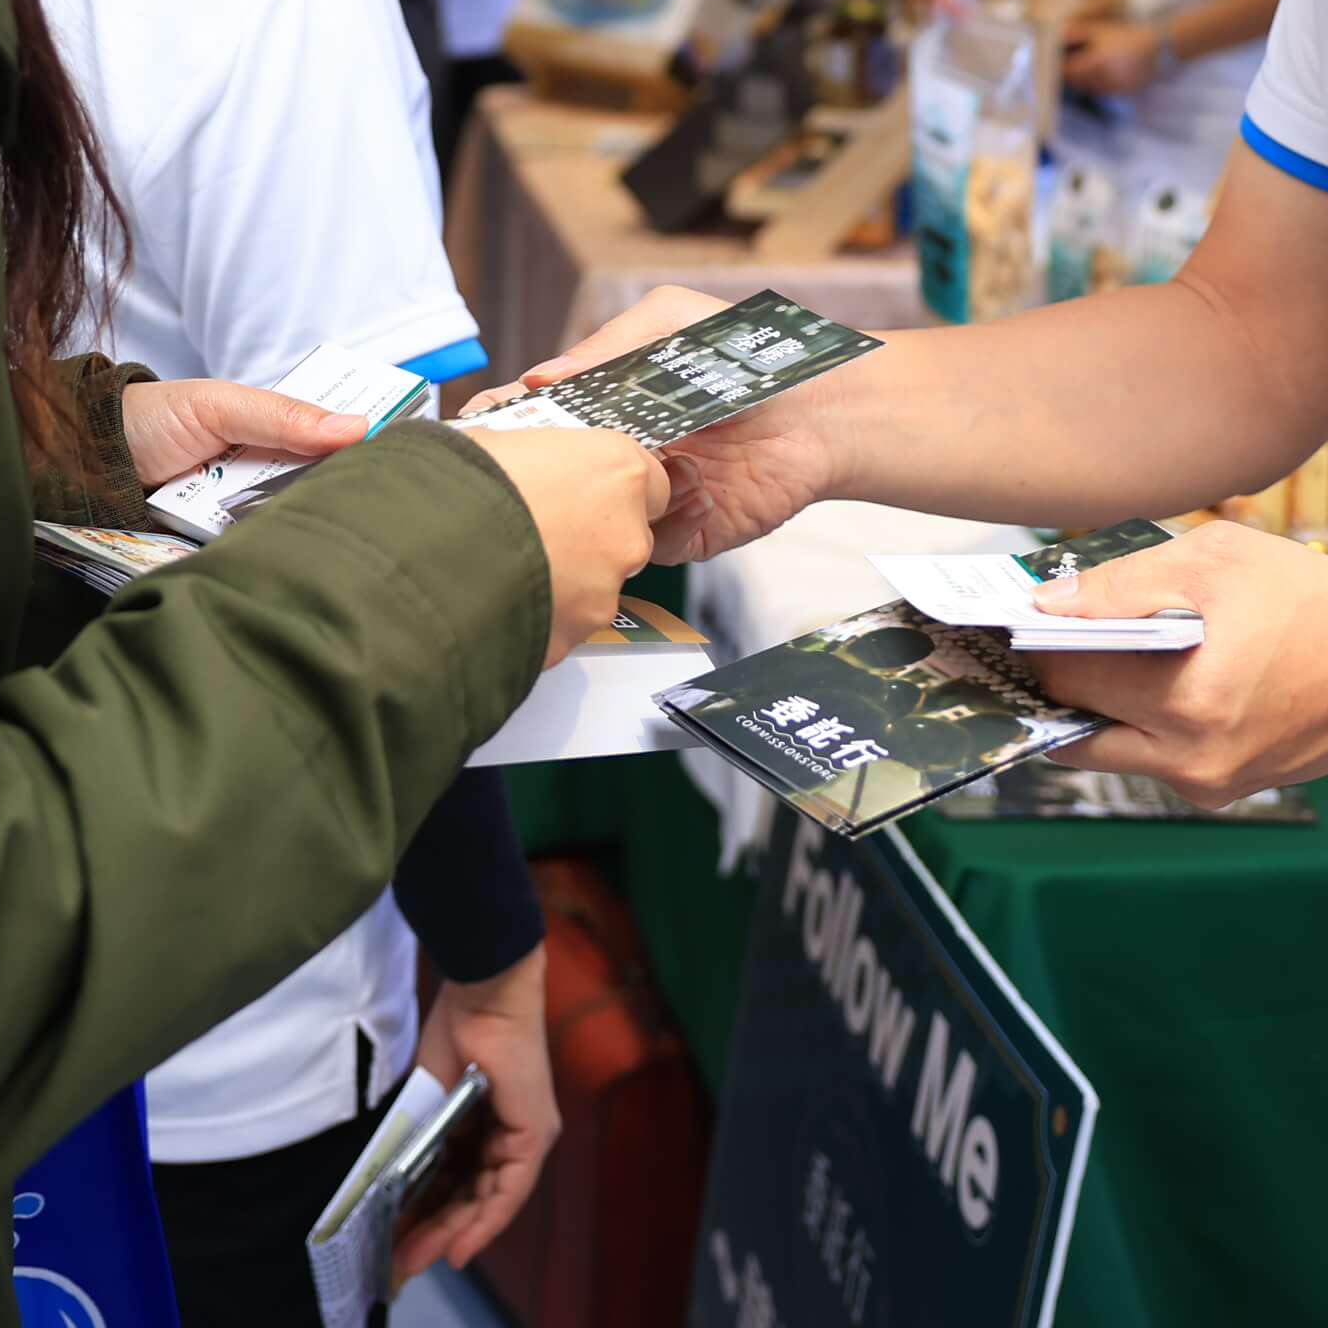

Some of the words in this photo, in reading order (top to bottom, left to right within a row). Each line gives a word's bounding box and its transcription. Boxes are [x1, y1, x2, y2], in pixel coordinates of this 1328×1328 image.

[726, 326, 806, 365] 基隆
[760, 695, 889, 769] 委託行
[782, 812, 916, 1090] Follow
[910, 1010, 1000, 1231] Me
